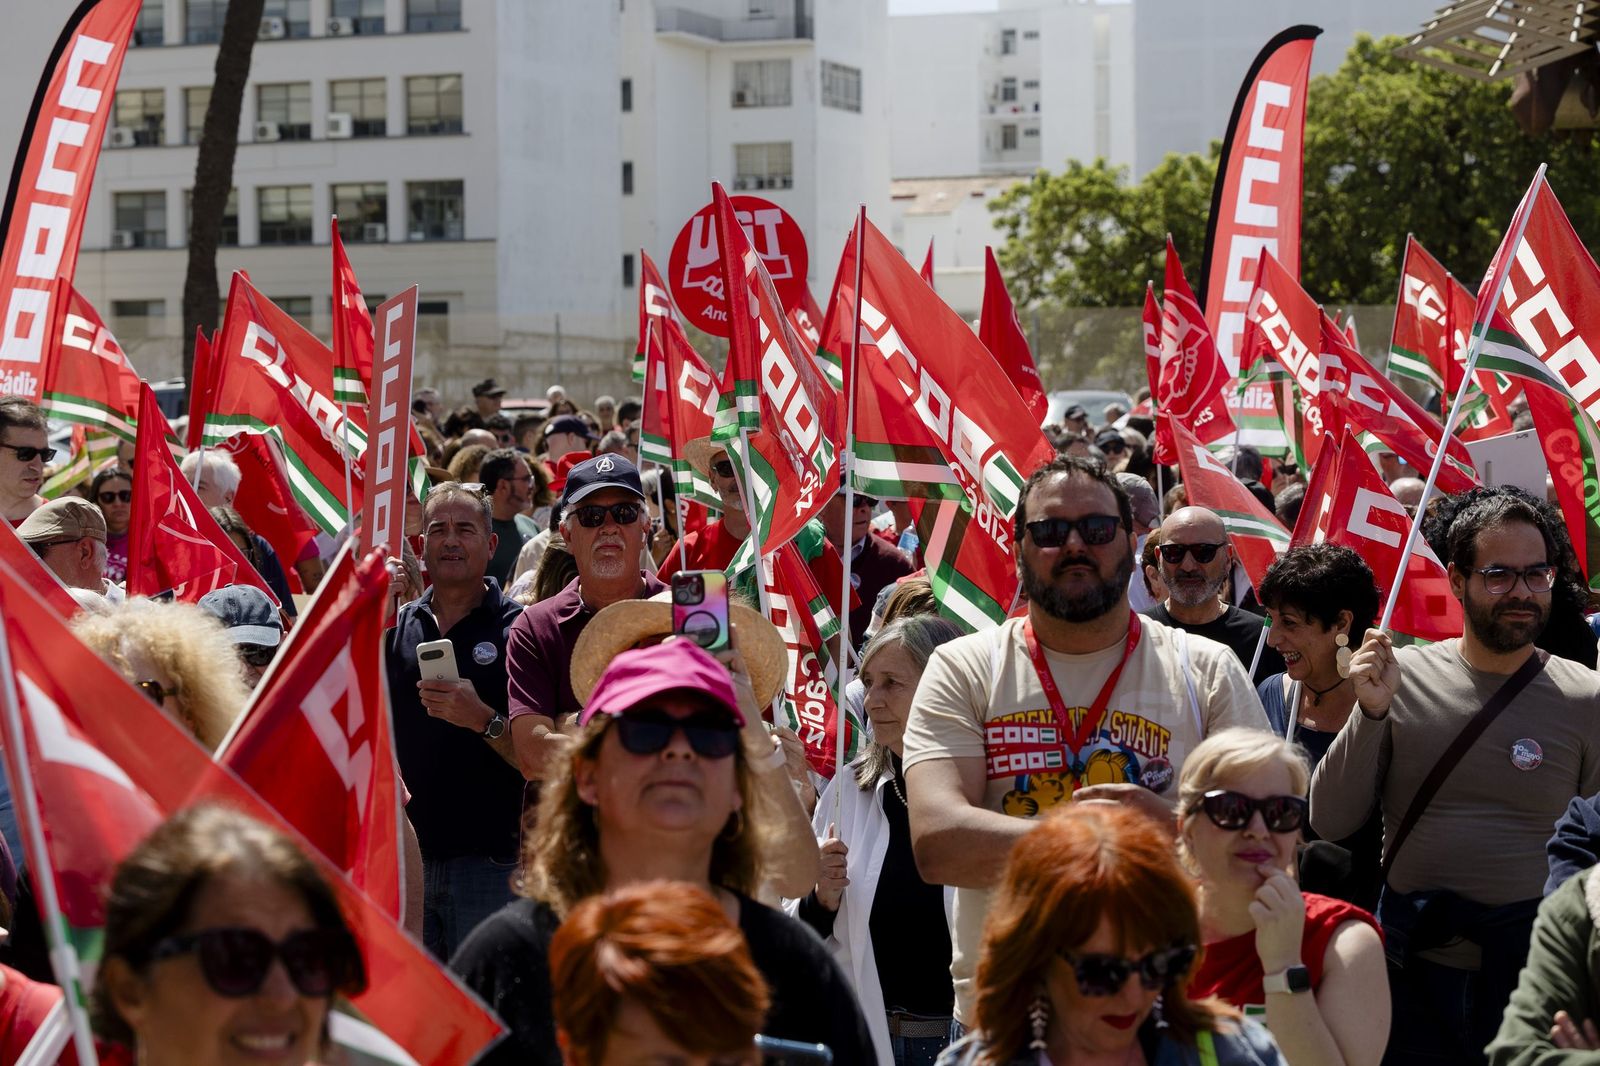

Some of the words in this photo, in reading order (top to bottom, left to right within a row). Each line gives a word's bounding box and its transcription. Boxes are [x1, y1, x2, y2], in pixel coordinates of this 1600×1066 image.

[0, 34, 115, 363] CCOO
[1248, 288, 1320, 397] CCOO
[1502, 236, 1600, 428] CO
[371, 302, 404, 547] CCOO
[1221, 386, 1274, 410] ádiz
[797, 652, 828, 750] Cádiz
[984, 726, 1040, 745] COO
[1110, 711, 1171, 760] STATE
